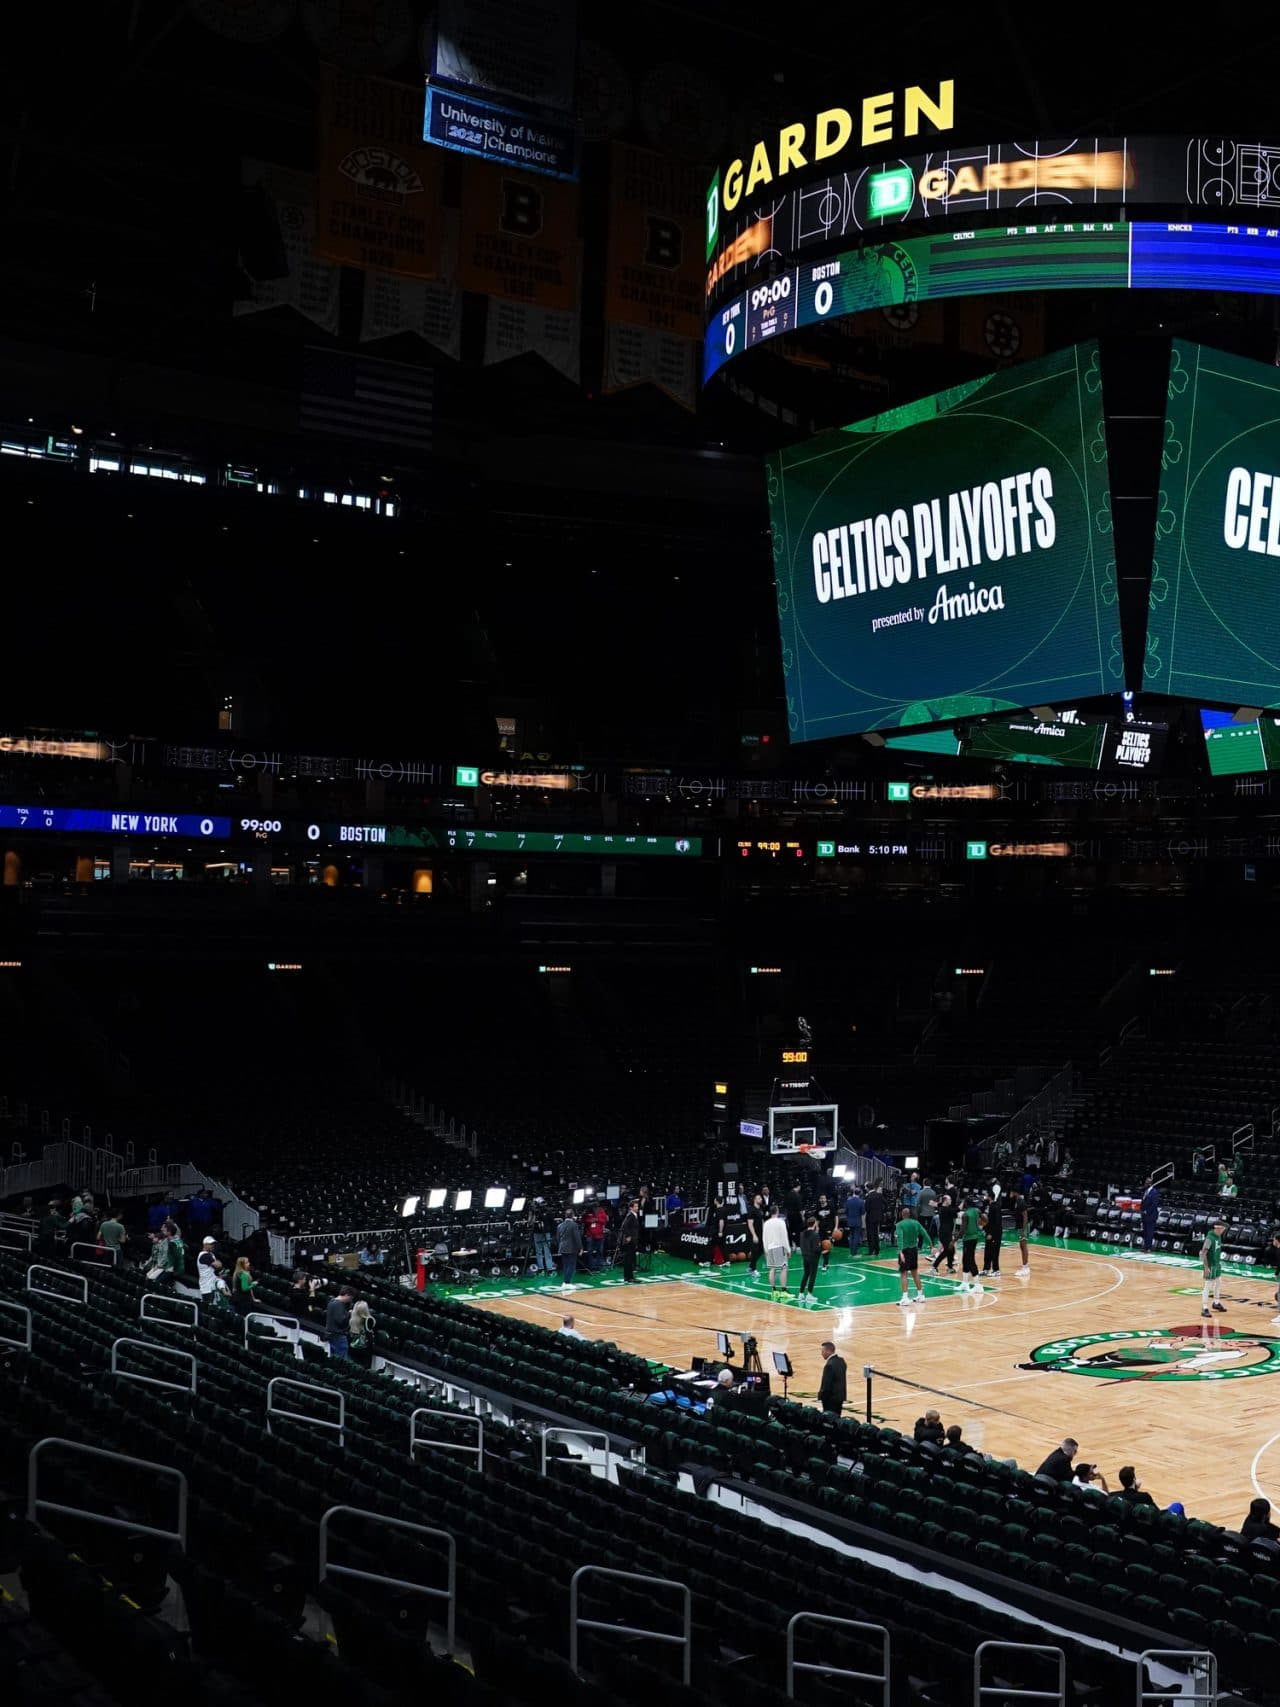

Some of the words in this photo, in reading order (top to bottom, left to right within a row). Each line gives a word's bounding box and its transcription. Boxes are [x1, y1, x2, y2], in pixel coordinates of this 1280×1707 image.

[441, 103, 507, 138] University
[510, 127, 525, 139] of
[488, 137, 559, 165] Champions
[723, 79, 954, 211] GARDEN
[953, 231, 976, 240] CELTICS
[1168, 224, 1193, 232] KNICKS
[1267, 229, 1279, 237] AST
[812, 262, 841, 282] BOSTON
[752, 277, 790, 311] 99:00
[815, 281, 834, 315] 0
[725, 324, 736, 355] 0
[813, 508, 911, 603] CELTICS
[913, 467, 1056, 579] PLAYOFFS
[872, 608, 913, 632] presented
[914, 606, 925, 622] by
[929, 581, 1005, 625] Amica
[1034, 723, 1066, 737] Amica
[1122, 731, 1150, 748] CELTICS
[1116, 745, 1151, 763] PLAYOFFS
[21, 816, 27, 825] 7
[45, 818, 52, 826] 0
[112, 814, 139, 831] NEW
[144, 816, 178, 833] YORK
[200, 819, 214, 835] 0
[241, 819, 281, 832] 99:00
[307, 825, 320, 840] 0
[340, 826, 386, 843] BOSTON
[449, 838, 456, 847] 0
[468, 839, 474, 847] 7
[819, 843, 834, 855] TD
[837, 845, 860, 853] Bank
[869, 846, 891, 854] 5:10
[892, 846, 908, 854] PM
[783, 1052, 808, 1062] 99:00
[681, 1233, 709, 1245] coinbase
[1041, 1330, 1162, 1357] BOSTON
